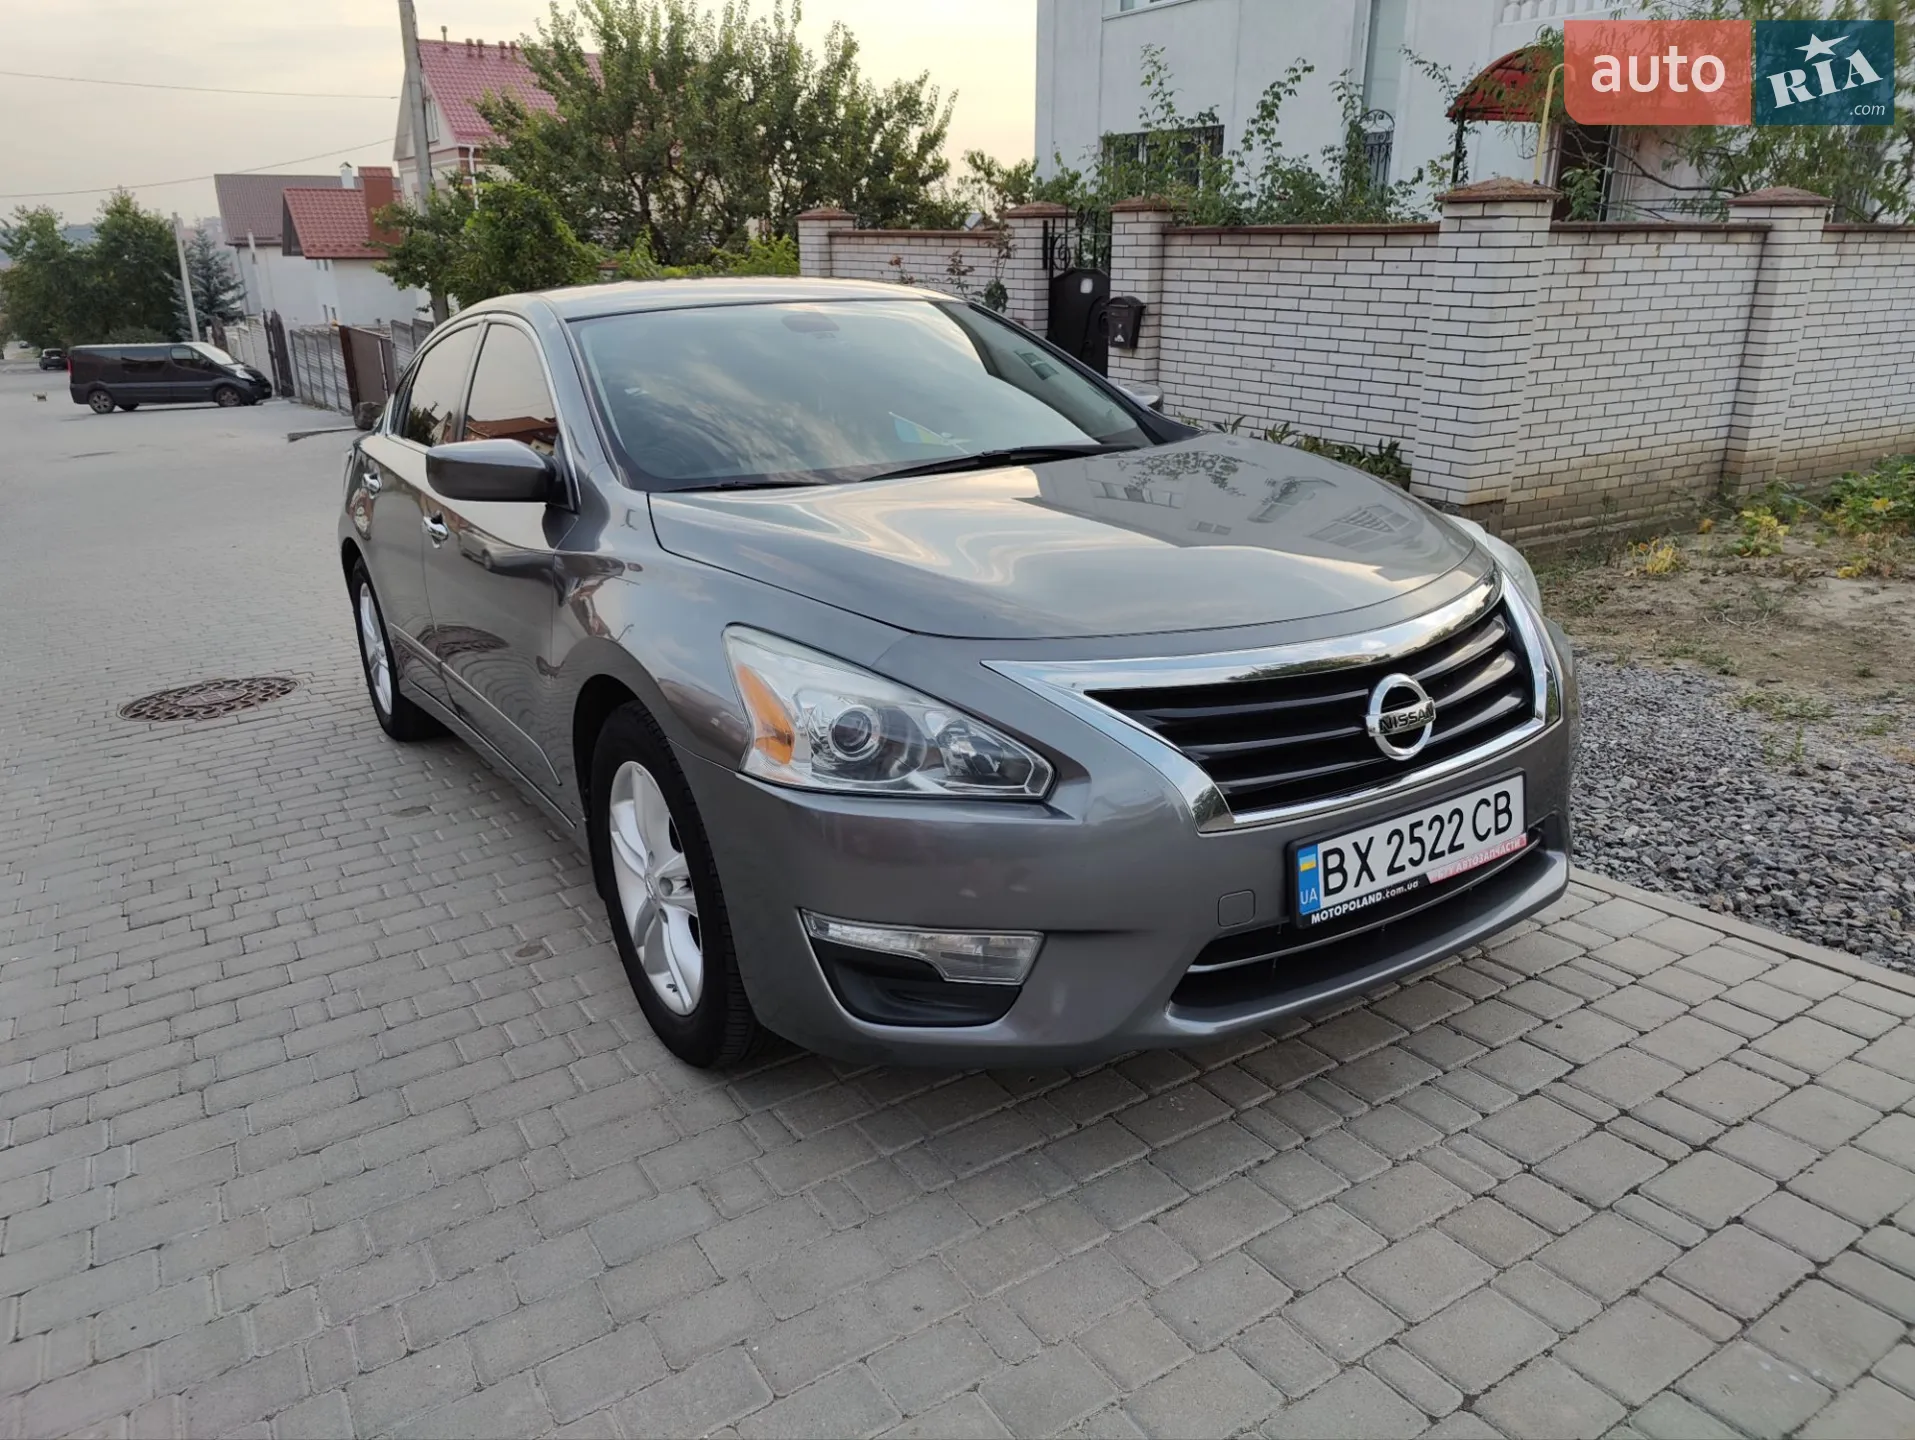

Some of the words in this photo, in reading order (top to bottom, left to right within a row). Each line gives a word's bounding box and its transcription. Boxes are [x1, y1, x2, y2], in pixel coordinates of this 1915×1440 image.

[1379, 701, 1434, 734] NISSAN
[1322, 836, 1376, 897] BX
[1386, 807, 1465, 876] 2522
[1472, 790, 1513, 842] CB
[1300, 887, 1318, 905] UA
